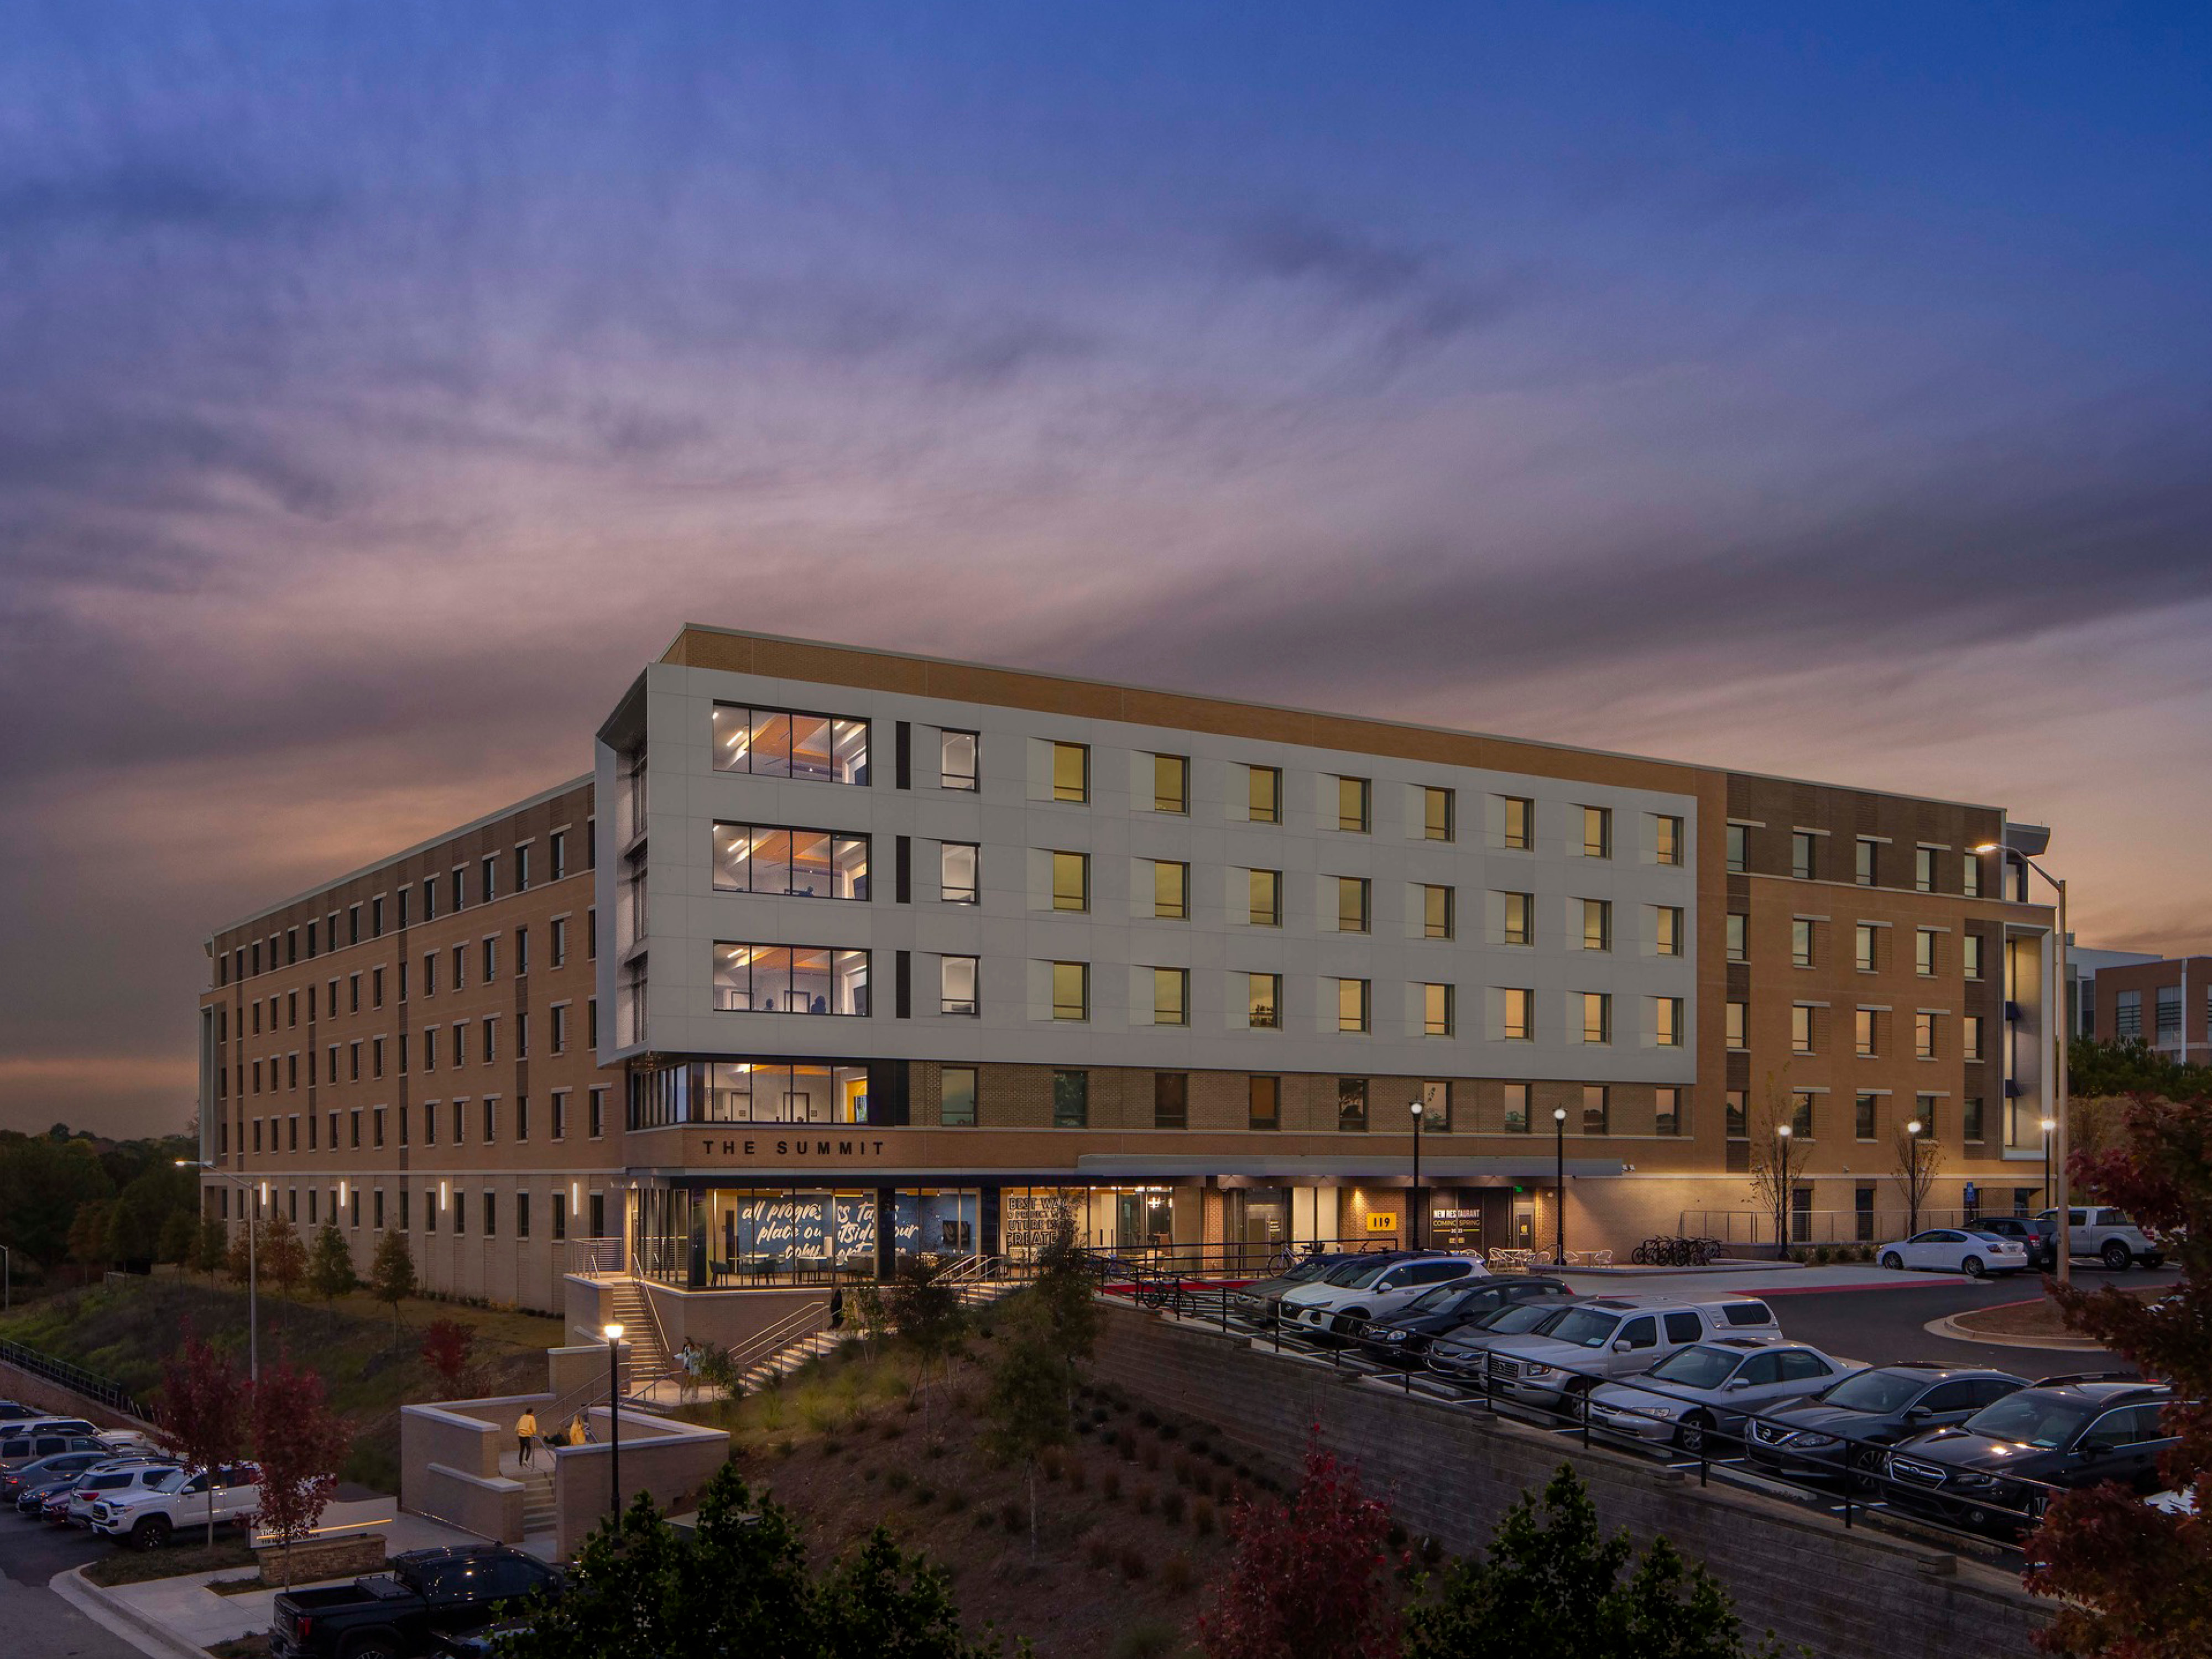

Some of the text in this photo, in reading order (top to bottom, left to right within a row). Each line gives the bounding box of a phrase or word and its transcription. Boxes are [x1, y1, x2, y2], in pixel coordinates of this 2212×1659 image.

[703, 1140, 883, 1155] THE SUMMIT
[742, 1200, 766, 1222] all
[1433, 1209, 1480, 1218] NEW RESTAURANT
[1374, 1217, 1390, 1227] 119
[756, 1221, 799, 1245] place
